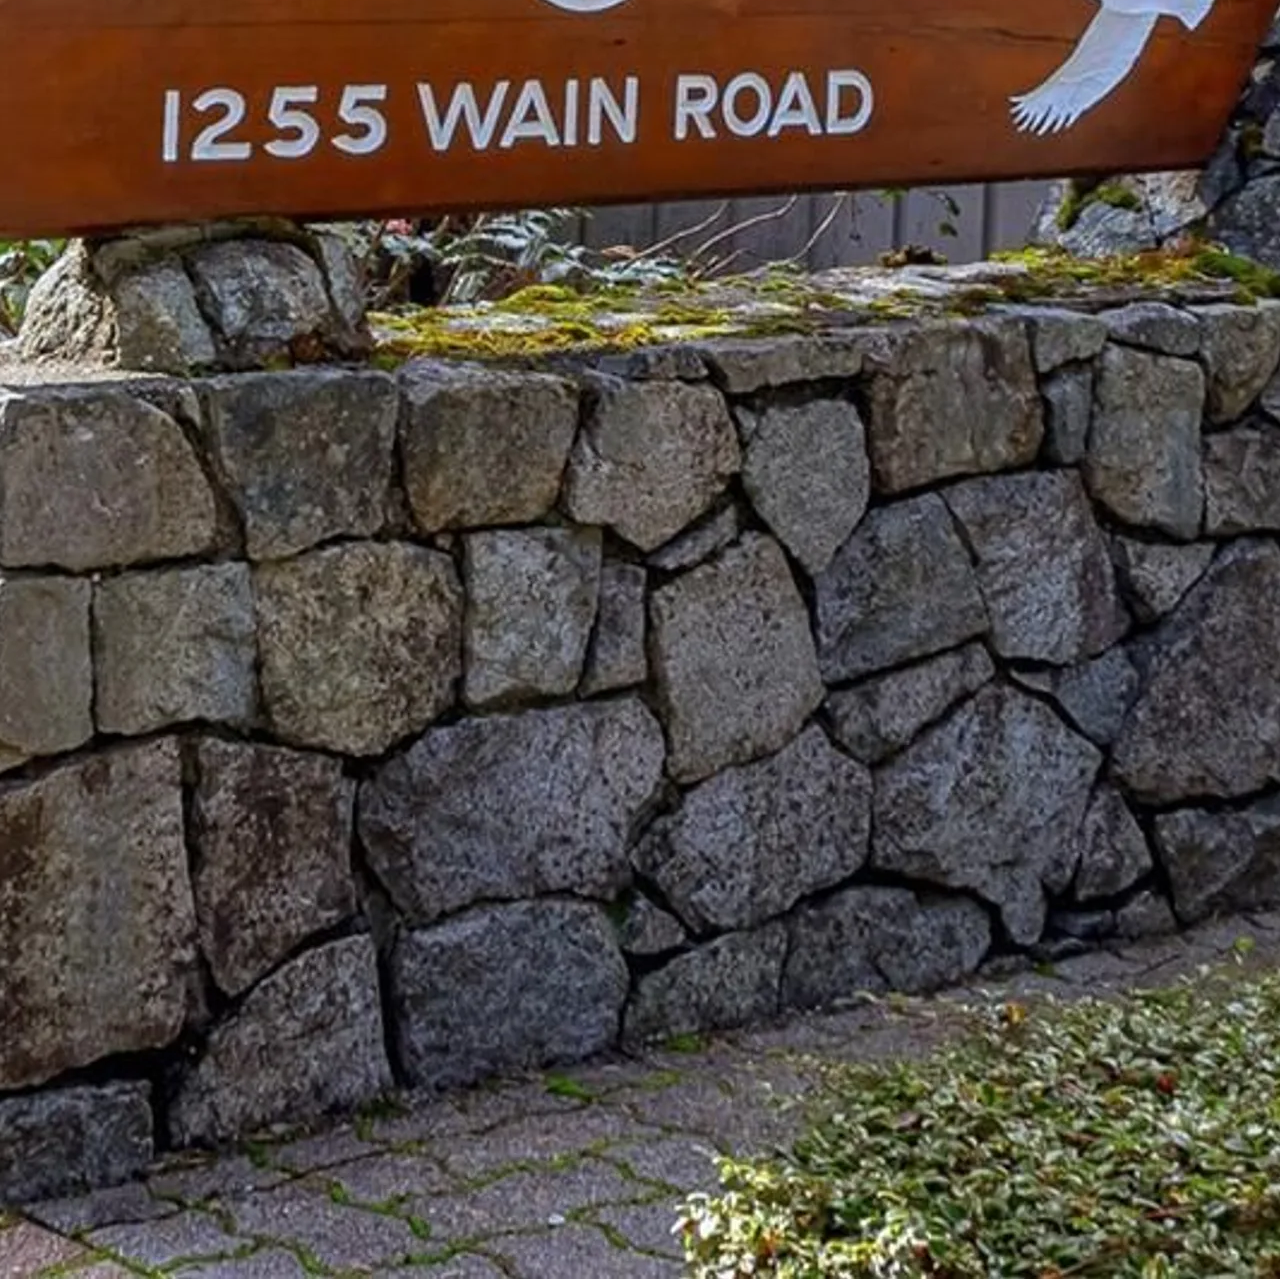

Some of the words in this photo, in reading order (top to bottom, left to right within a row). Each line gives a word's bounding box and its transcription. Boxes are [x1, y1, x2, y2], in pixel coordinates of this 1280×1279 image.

[162, 84, 388, 163] 1255
[417, 75, 639, 151] WAIN
[674, 70, 874, 140] ROAD
